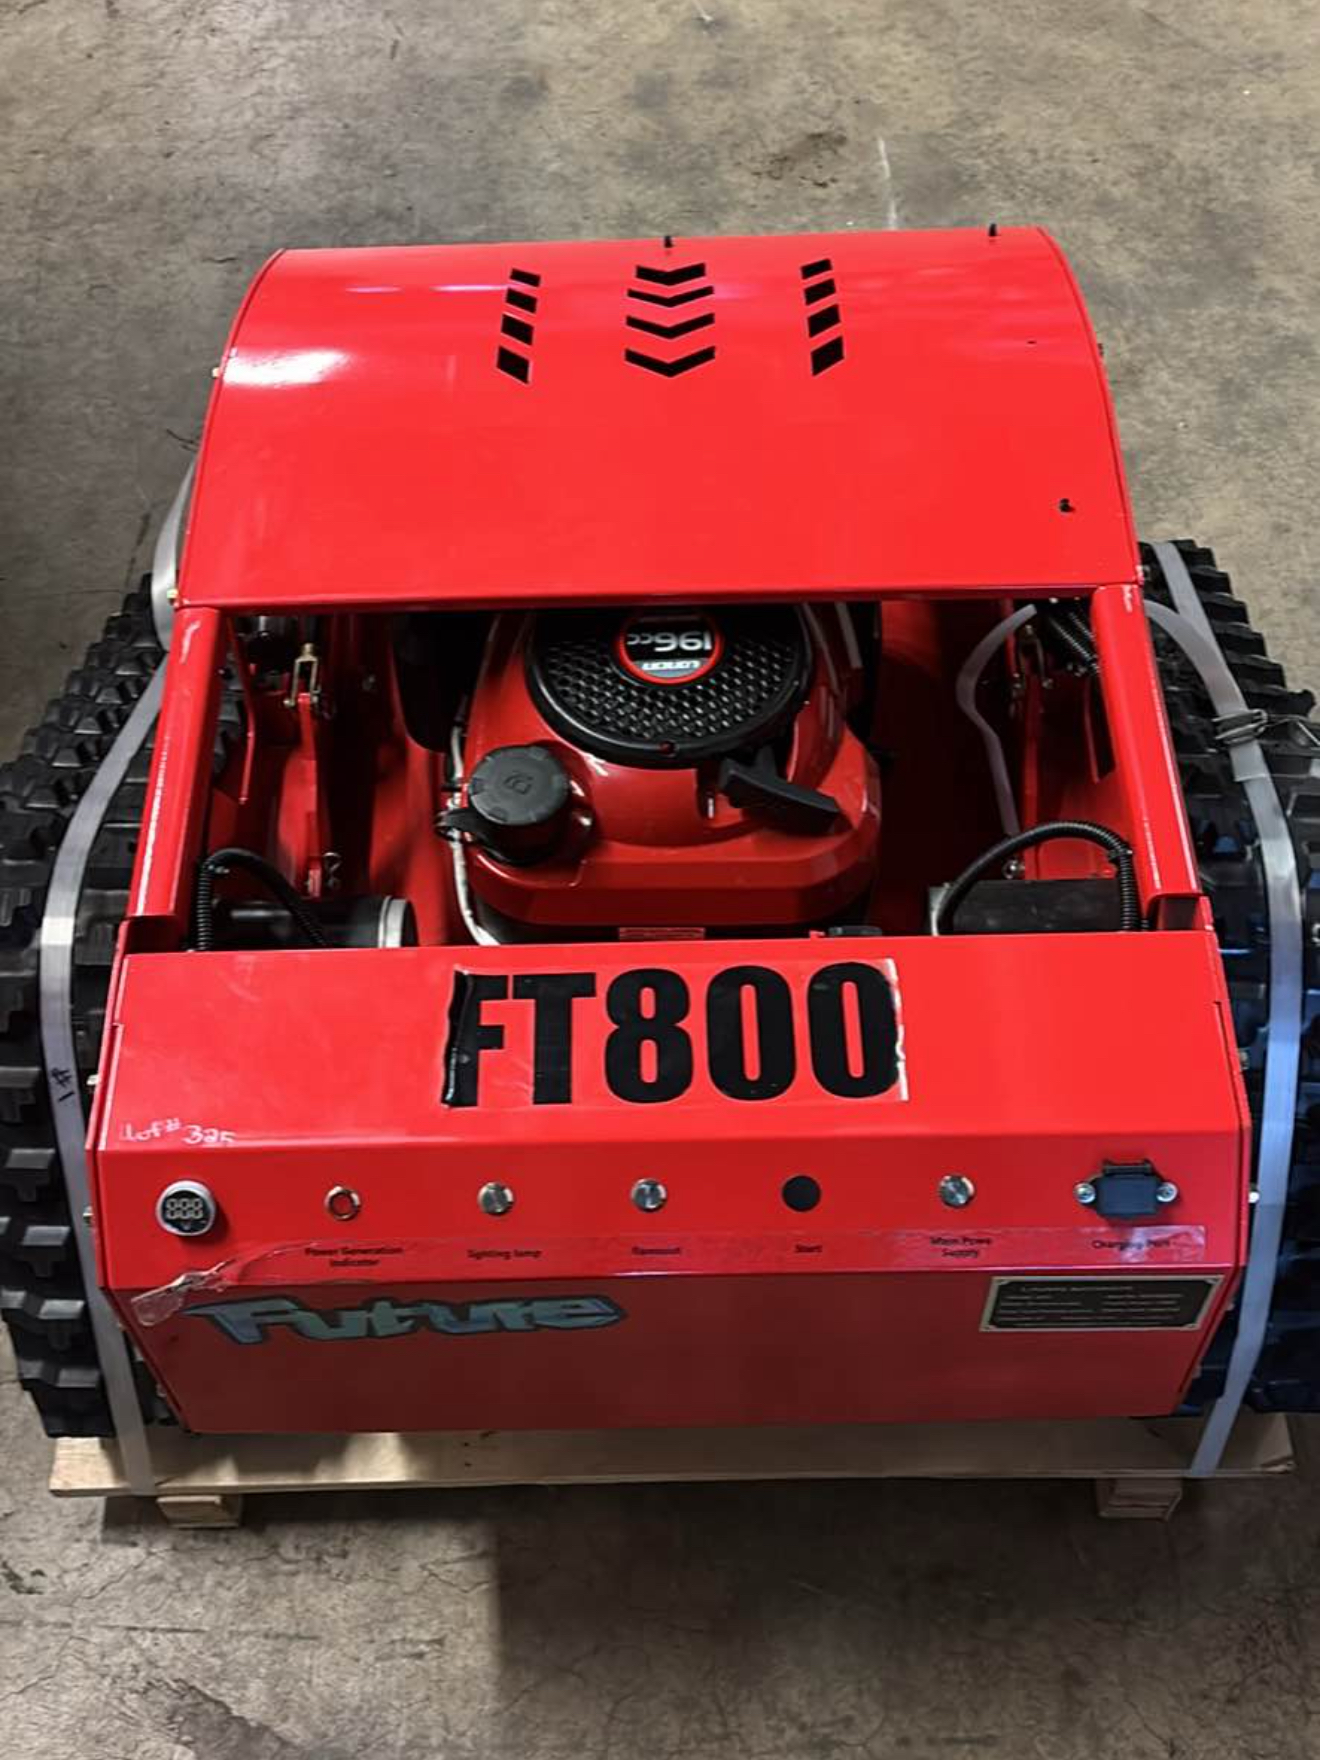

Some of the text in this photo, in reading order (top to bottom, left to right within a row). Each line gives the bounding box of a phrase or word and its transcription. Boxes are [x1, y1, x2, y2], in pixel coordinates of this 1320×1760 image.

[625, 631, 713, 653] 196cc
[440, 961, 904, 1107] FT800
[182, 1294, 627, 1346] Future
